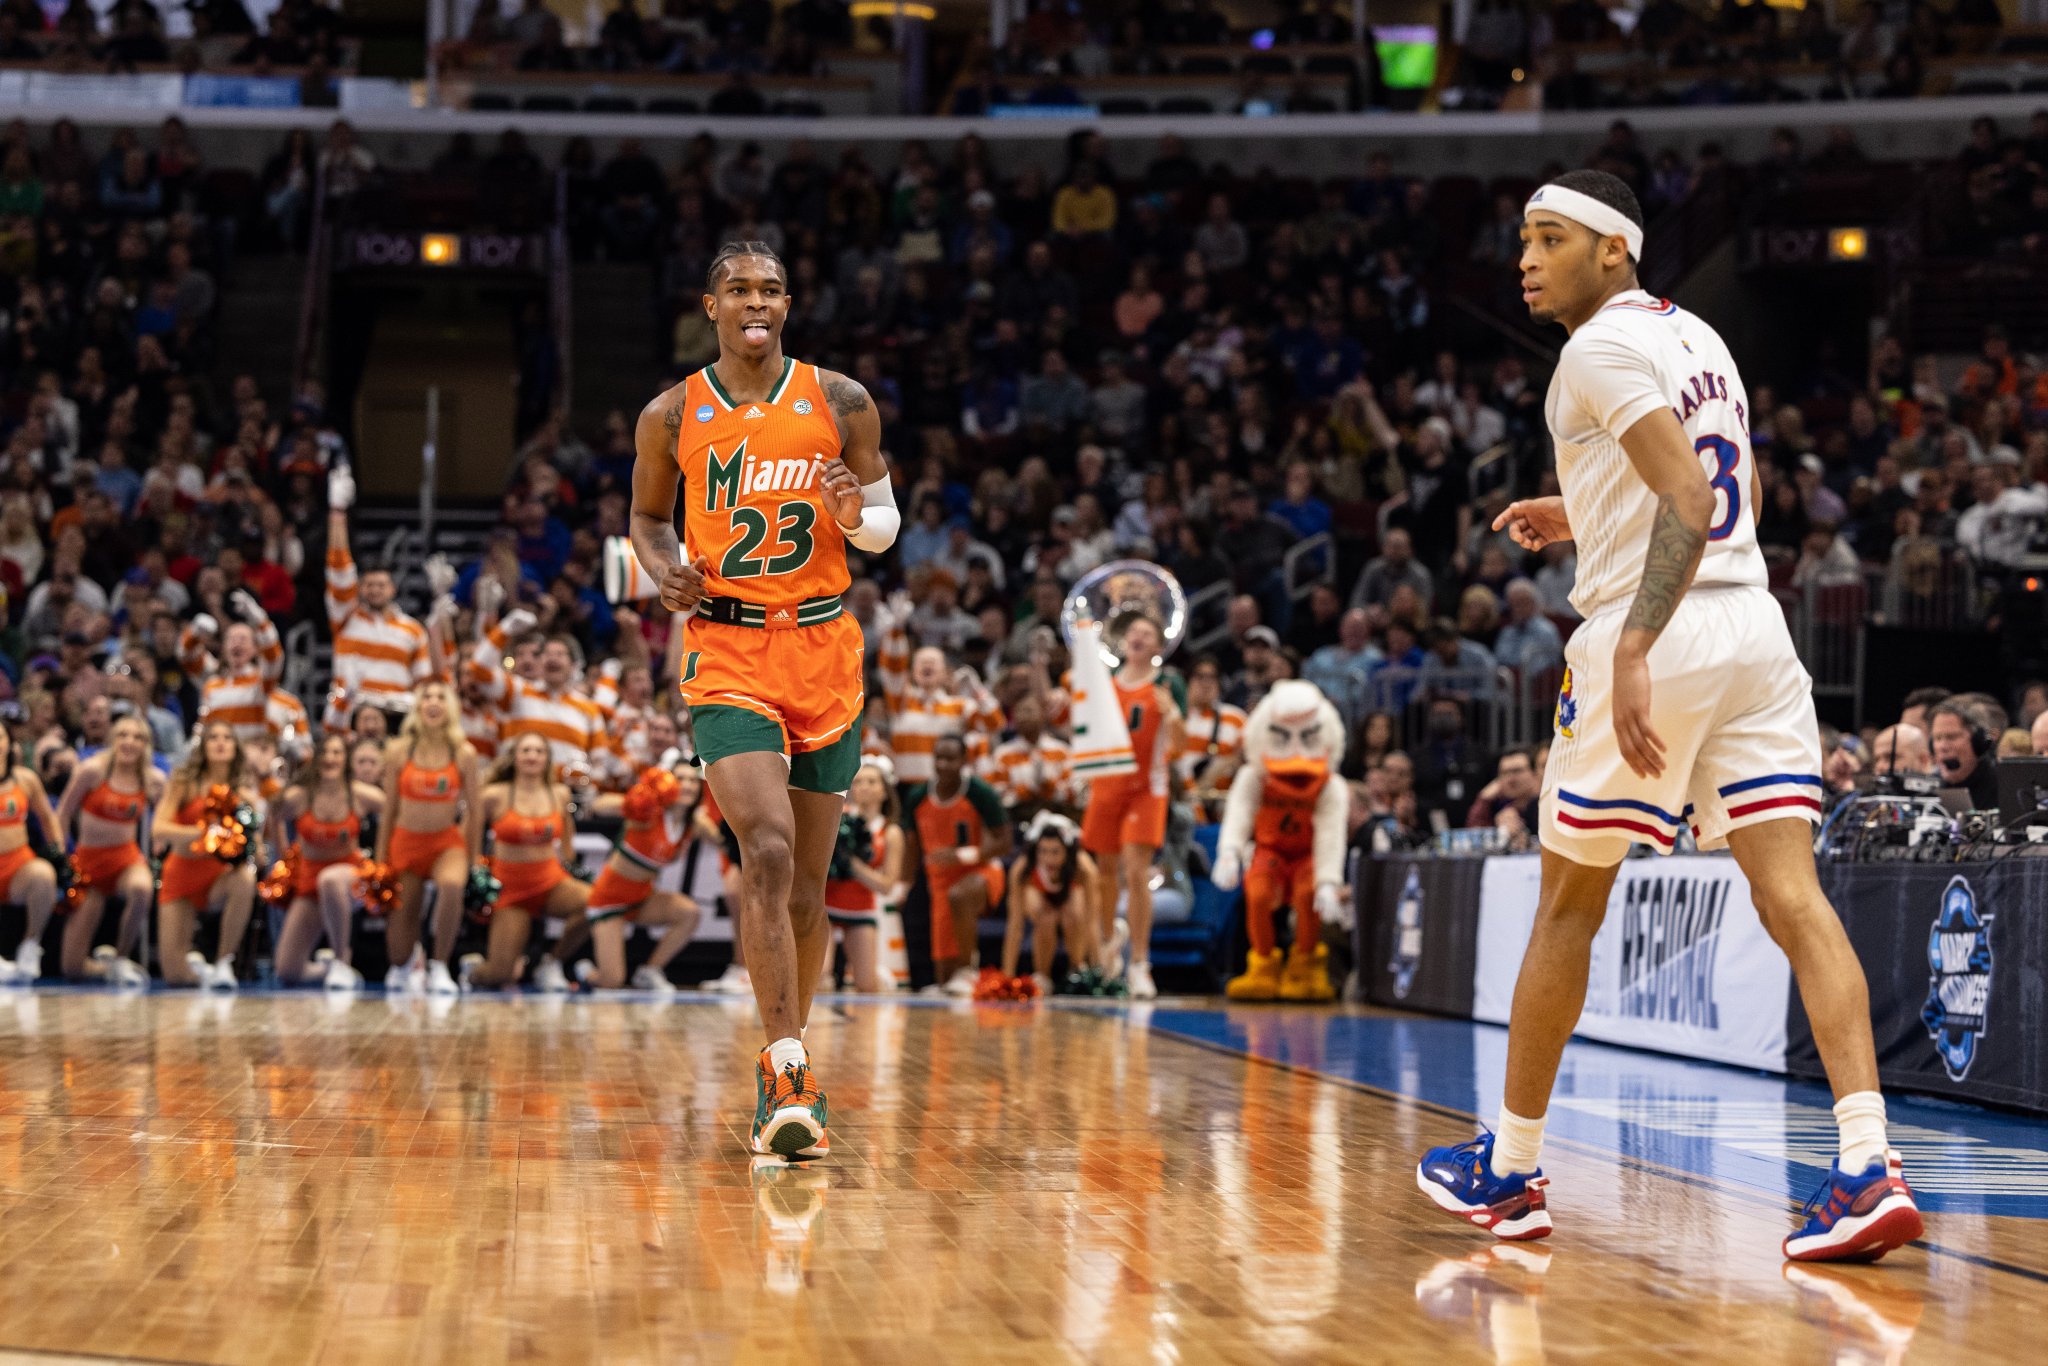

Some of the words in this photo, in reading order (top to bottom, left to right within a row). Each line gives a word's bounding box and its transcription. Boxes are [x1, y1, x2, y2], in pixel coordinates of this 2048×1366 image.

[470, 234, 521, 267] 107
[743, 411, 766, 420] adidas
[706, 435, 823, 512] Miami
[720, 500, 817, 580] 23
[1619, 876, 1731, 1031] REGIONAL
